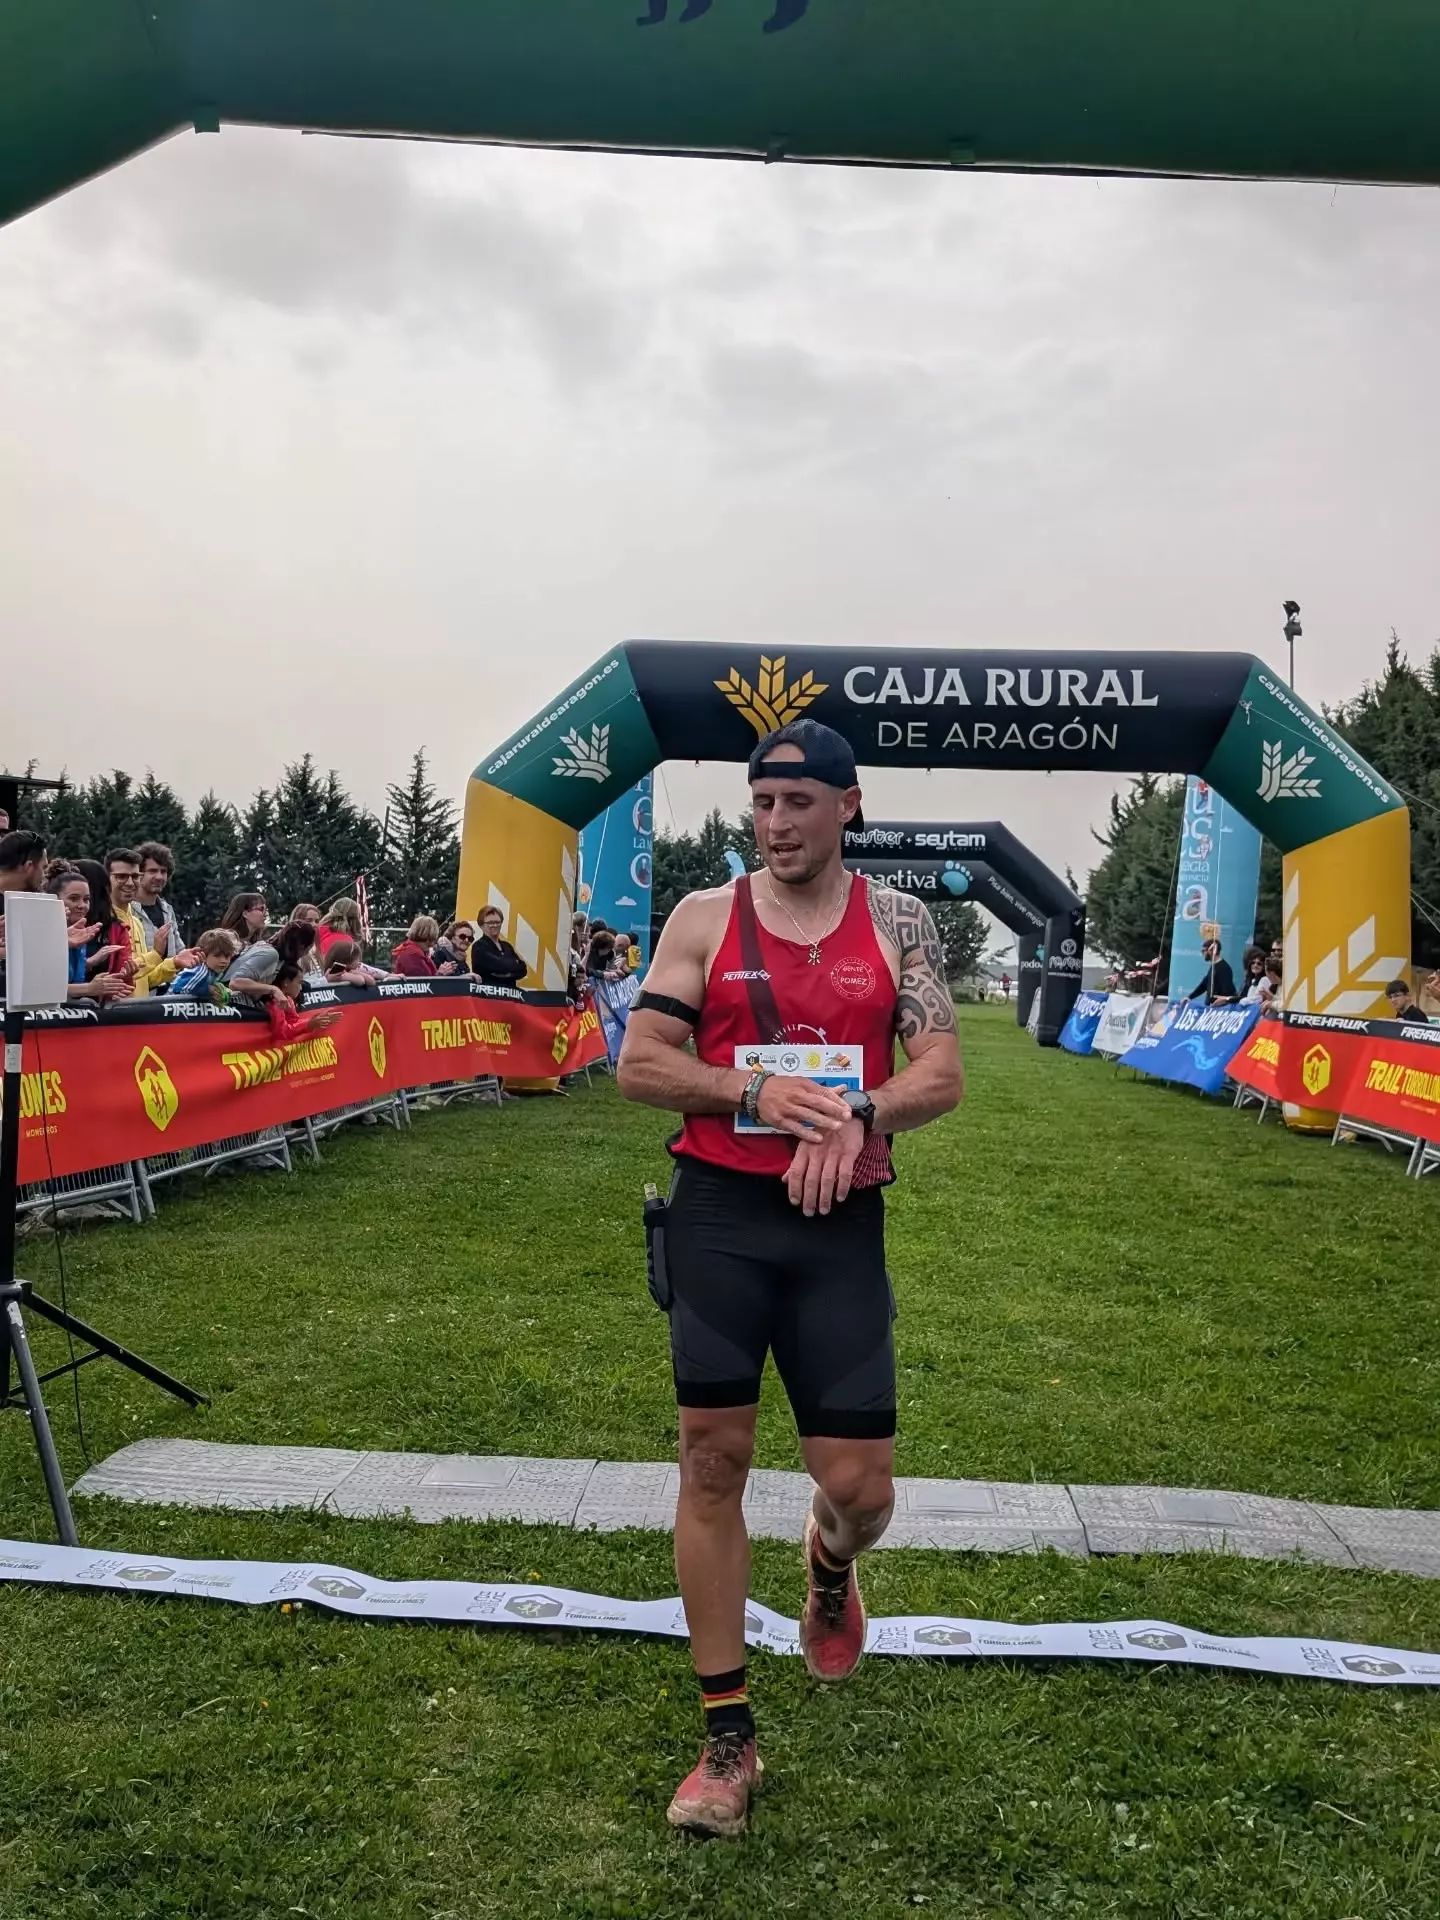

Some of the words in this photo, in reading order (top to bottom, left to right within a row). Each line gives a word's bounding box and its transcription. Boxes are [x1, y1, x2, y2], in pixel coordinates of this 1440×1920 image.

[843, 665, 972, 706] CAJA
[984, 668, 1160, 707] RURAL
[487, 659, 619, 775] cajaruraldearagon.es
[877, 721, 929, 748] DE
[941, 716, 1119, 750] ARAGÓN
[1258, 674, 1389, 804] cajaruraldearagon.es
[915, 830, 986, 850] seytam
[377, 982, 434, 997] FIREHAWK
[469, 983, 525, 1001] FIREHAWK
[840, 976, 868, 986] POMEZ
[161, 1002, 242, 1020] FIREHAWK
[1174, 1003, 1198, 1030] Los
[421, 1018, 466, 1051] TRAIL
[1289, 1013, 1371, 1034] FIREHAWK
[1400, 1026, 1440, 1042] FIREHAW
[1365, 1059, 1404, 1095] TRAIL
